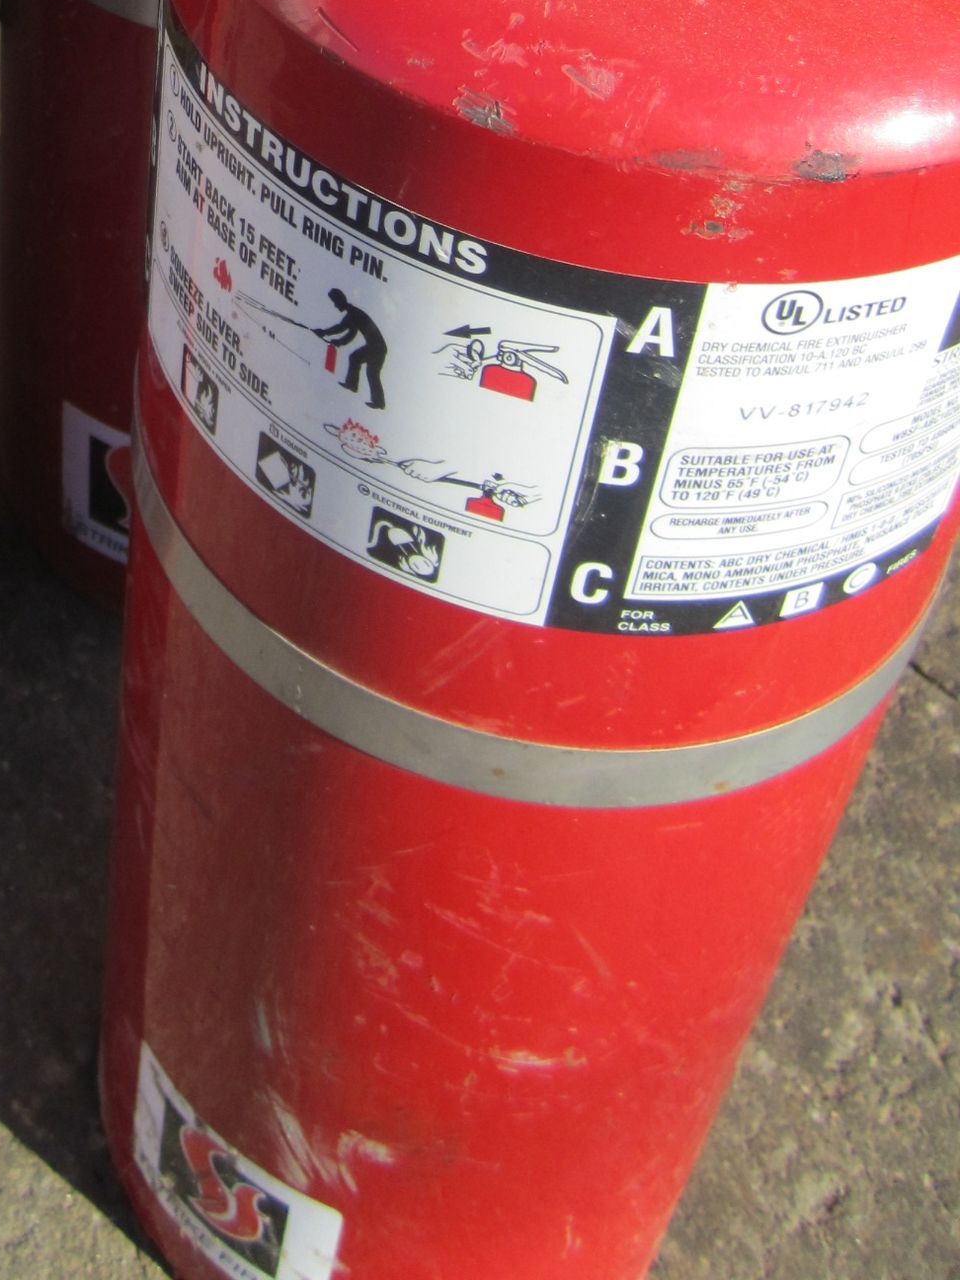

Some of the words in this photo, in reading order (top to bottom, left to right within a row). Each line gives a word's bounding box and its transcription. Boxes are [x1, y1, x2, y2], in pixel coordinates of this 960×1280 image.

[199, 62, 488, 276] INSTRUCTIONS
[180, 85, 202, 133] HOLD
[203, 122, 257, 195] UPRIGHT.
[260, 182, 298, 230] PULL
[302, 214, 345, 259] RING
[349, 245, 389, 283] PIN.
[177, 133, 204, 187] START
[205, 177, 236, 226] BACK
[239, 218, 256, 245] 15
[259, 233, 298, 281] FEET.
[176, 158, 191, 197] AIM
[193, 187, 206, 214] AT
[207, 204, 236, 252] BASE
[239, 243, 257, 270] OF
[260, 261, 299, 307] FIRE.
[170, 245, 205, 312] SQUEEZE
[206, 301, 244, 358] LEVER.
[775, 299, 807, 326] UL
[823, 296, 907, 324] LISTED
[168, 266, 196, 317] SWEEP
[196, 312, 219, 354] SIDE
[221, 342, 237, 371] TO
[239, 362, 273, 407] SIDE.
[626, 306, 675, 358] A
[701, 341, 728, 352] DRY
[731, 341, 793, 352] CHEMICAL
[796, 338, 825, 350] FIRE
[826, 323, 908, 348] EXTINGUISHER
[696, 366, 741, 377] TESTED
[745, 366, 761, 377] TO
[763, 366, 810, 377] ANSI/UL
[838, 356, 863, 369] AND
[698, 353, 797, 365] CLASSIFICATION
[739, 391, 870, 420] VV-817942
[598, 440, 644, 486] B
[677, 462, 792, 478] TEMPERATURES
[795, 455, 837, 470] FROM
[680, 453, 751, 467] SUITABLE
[754, 451, 784, 465] FOR
[787, 446, 816, 461] USE
[817, 443, 835, 456] AT
[671, 490, 690, 501] TO
[673, 478, 723, 489] MINUS
[371, 491, 421, 520] ELECTRICAL
[422, 514, 474, 538] EQUIPMENT
[669, 517, 720, 527] RECHARGE
[722, 512, 782, 525] IMMEDIATELY
[784, 506, 811, 519] AFTER
[717, 525, 736, 535] ANY
[646, 558, 715, 570] CONTENTS:
[719, 557, 743, 568] ABC
[746, 554, 771, 566] DRY
[774, 540, 830, 561] CHEMICAL
[570, 562, 613, 605] C
[682, 570, 721, 580] MONO
[724, 560, 794, 578] AMMONIUM
[702, 576, 765, 592] CONTENTS
[768, 568, 808, 583] UNDER
[794, 588, 810, 609] B
[618, 621, 671, 632] CLASS
[620, 610, 654, 620] FOR
